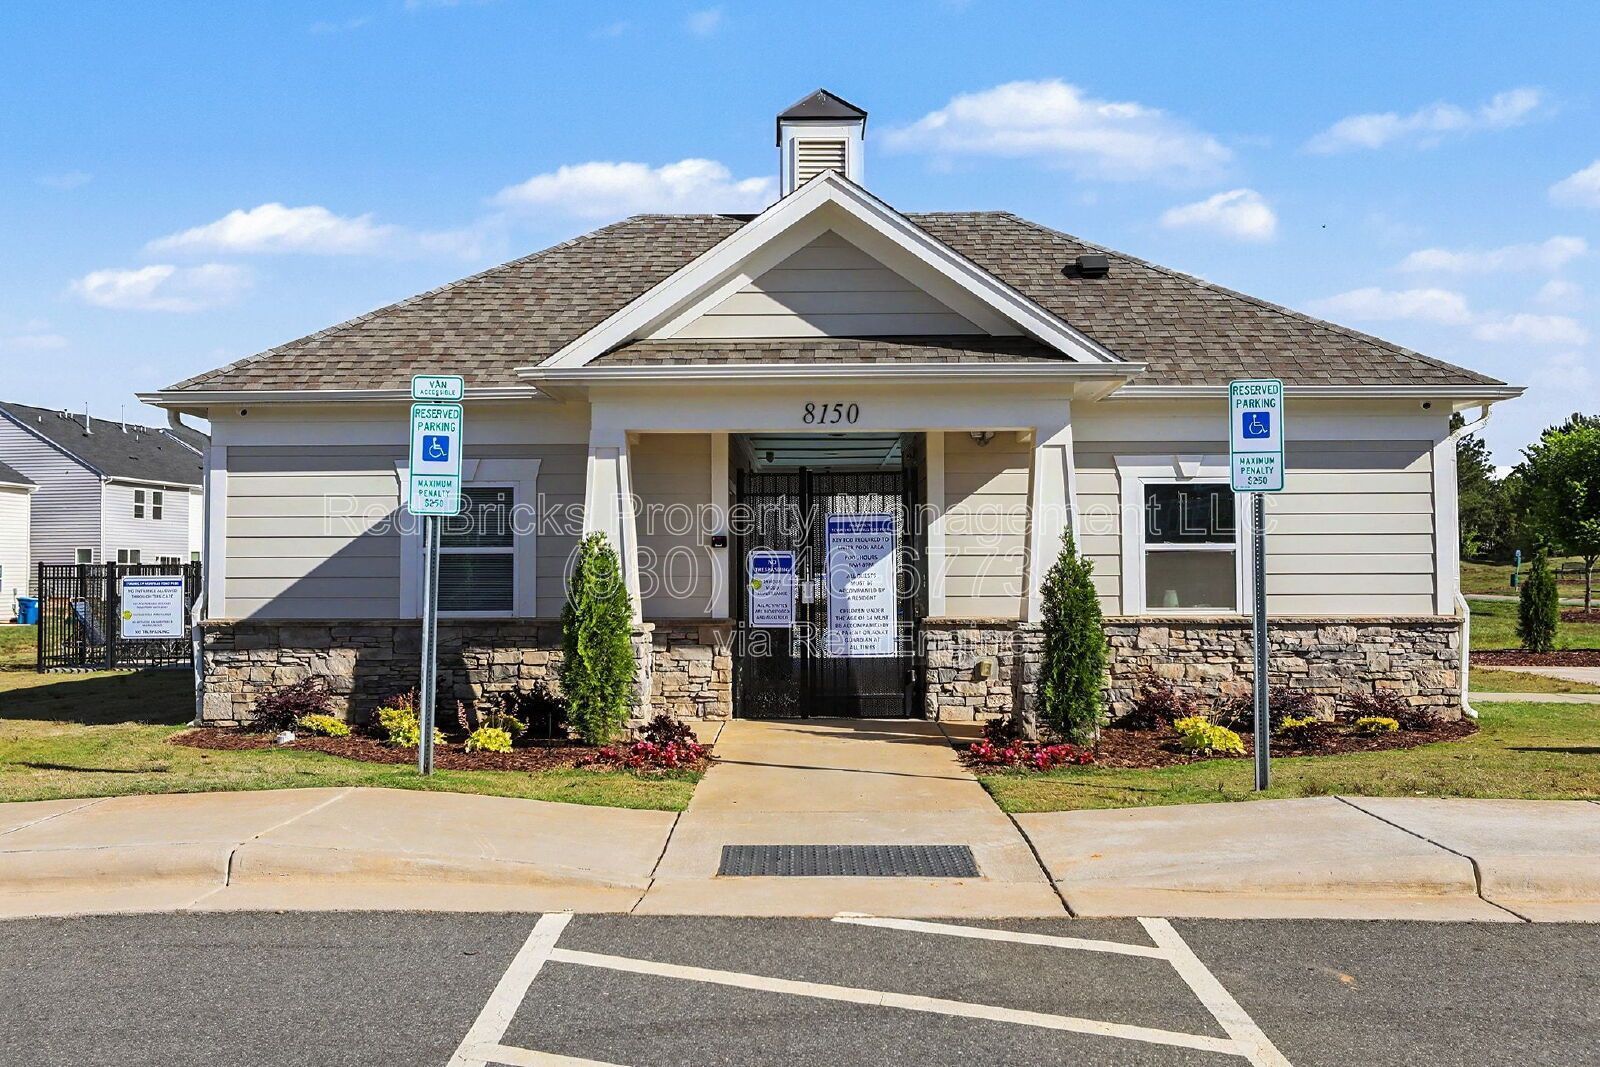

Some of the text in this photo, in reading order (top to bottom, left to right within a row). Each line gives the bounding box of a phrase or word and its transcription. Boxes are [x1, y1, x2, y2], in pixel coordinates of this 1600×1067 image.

[429, 380, 447, 388] VAN
[1232, 385, 1279, 396] RESERVED
[1236, 398, 1276, 409] PARKING
[415, 408, 459, 419] RESERVED
[803, 403, 860, 424] 8150
[417, 421, 456, 432] PARKING
[1239, 457, 1275, 465] MAXIMUM
[1240, 466, 1274, 475] PENALTY
[417, 479, 452, 488] MAXIMUM
[1247, 476, 1268, 486] $250
[418, 489, 450, 498] PENALTY
[424, 498, 444, 508] $250
